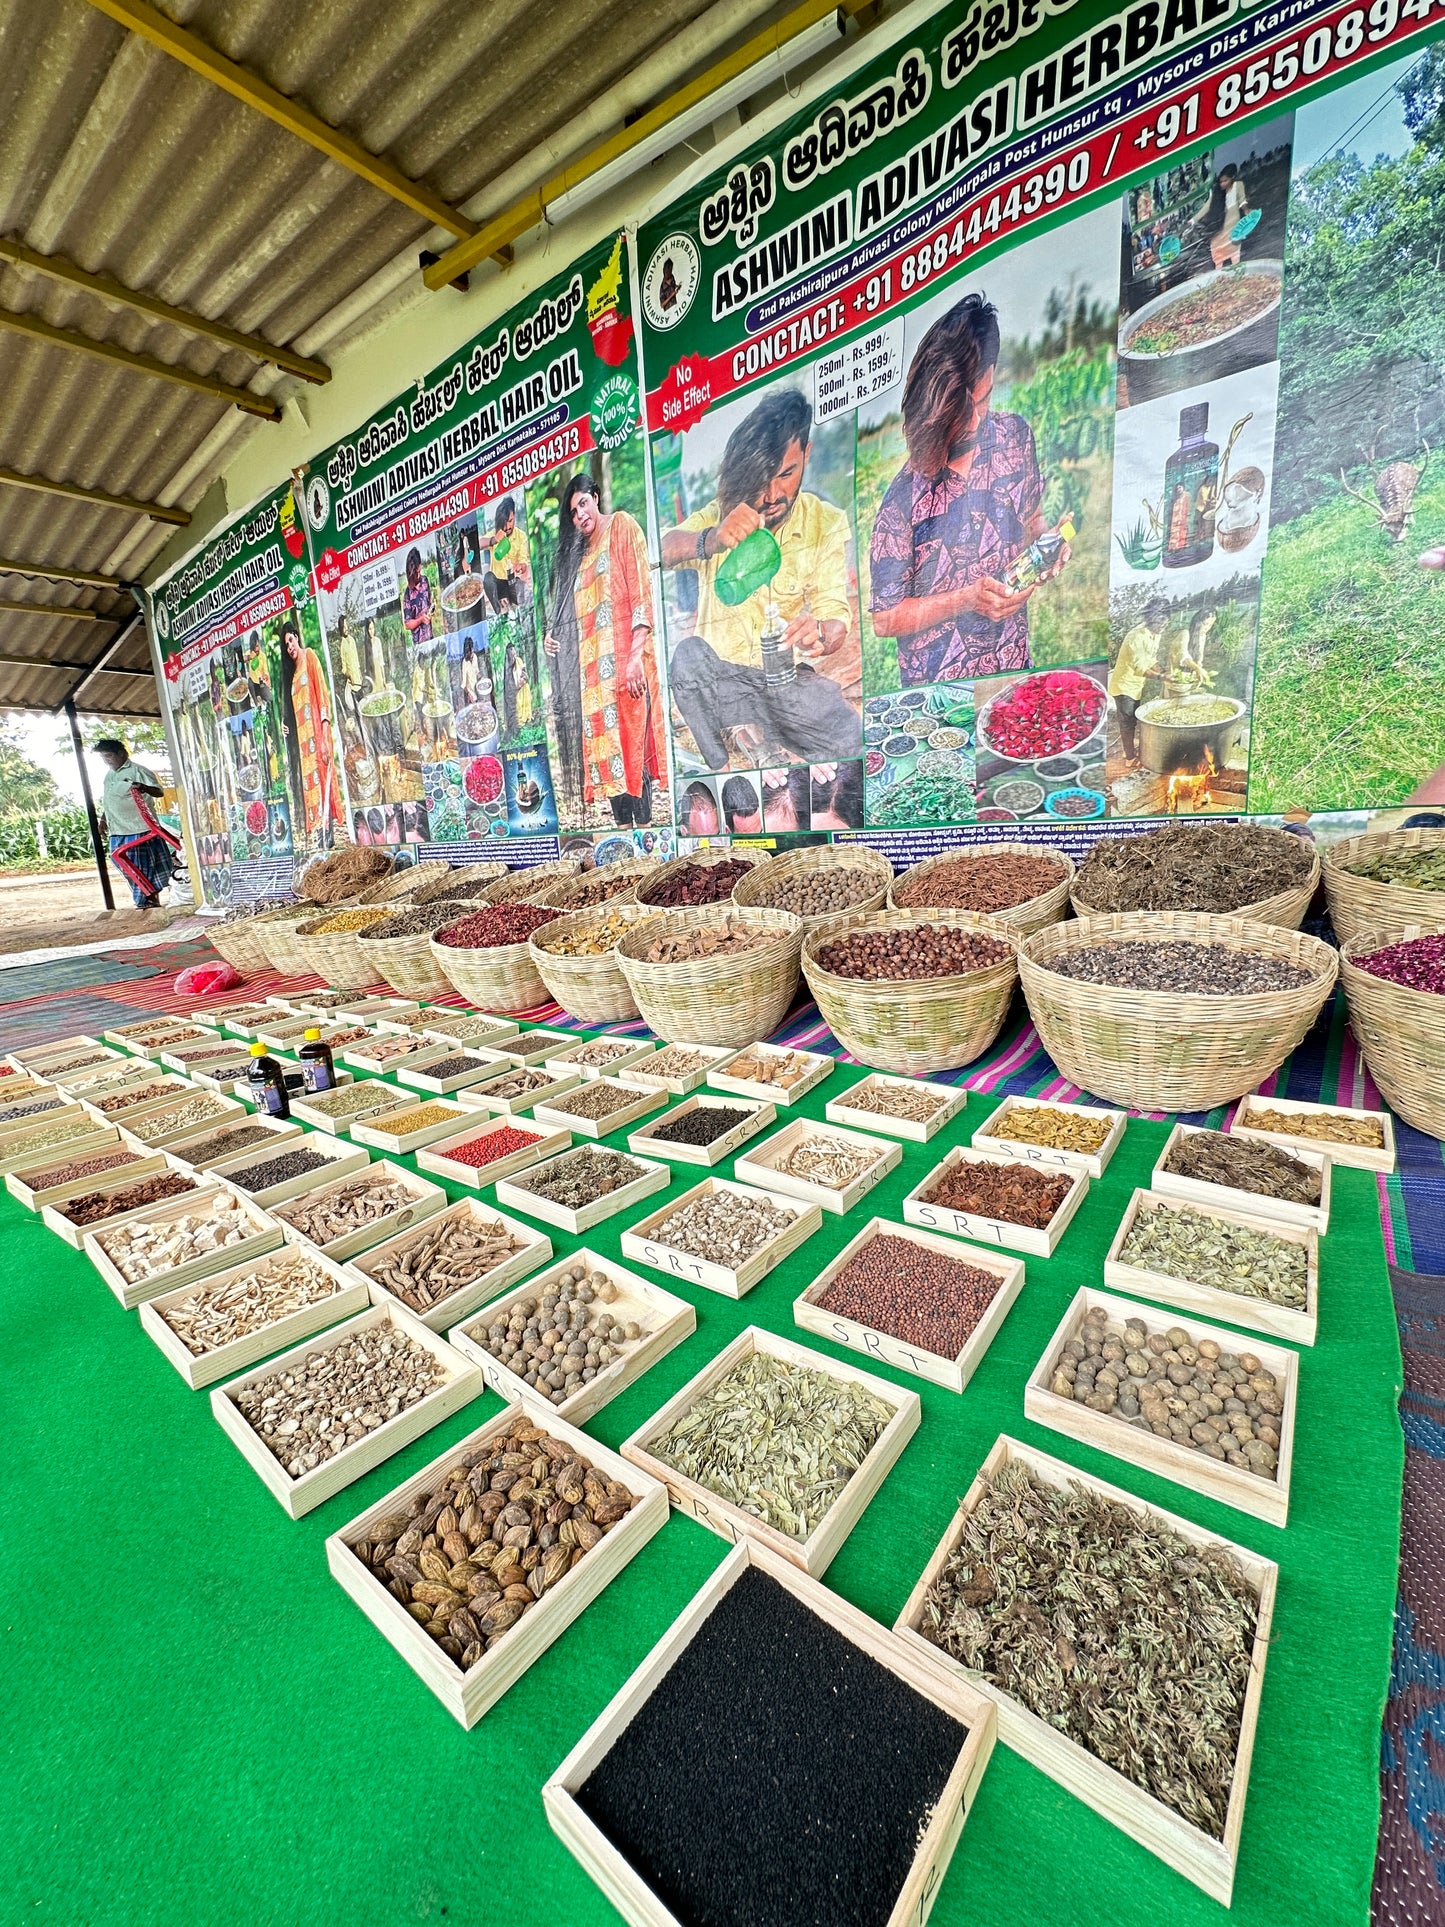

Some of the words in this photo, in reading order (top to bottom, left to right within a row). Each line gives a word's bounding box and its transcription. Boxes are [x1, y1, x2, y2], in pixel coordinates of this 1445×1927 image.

[787, 55, 927, 184] ಆದಿವಾಸಿ
[947, 0, 1039, 81] ಹರ್ಬ
[759, 304, 776, 321] 2nd
[779, 263, 848, 311] Pakshirajpura
[851, 236, 891, 271] Adivasi
[893, 208, 934, 243] Colony
[935, 162, 1000, 215] Nellurpala
[1004, 141, 1037, 168] Post
[1041, 109, 1100, 146] Hunsur
[1104, 97, 1122, 119] tq
[1136, 52, 1203, 99] Mysore
[1209, 28, 1248, 60] Dist
[1253, 0, 1323, 37] Karna
[716, 197, 848, 316] ASHWINI
[860, 85, 1009, 235] ADIVASI
[732, 301, 845, 381] CONCTACT:
[853, 268, 892, 312] +91
[901, 151, 1090, 291] 8884444390
[1134, 93, 1200, 149] +91
[1215, 0, 1445, 119] 855089
[646, 245, 668, 292] ADIVASI
[670, 239, 694, 264] HERBAL
[686, 265, 697, 298] HAIR
[645, 295, 670, 325] ASHWINI
[675, 300, 687, 317] OIL
[676, 365, 692, 387] No
[818, 354, 844, 379] 250ml
[852, 332, 890, 362] Rs.999/-
[819, 375, 845, 398] 500ml
[853, 365, 866, 382] Rs.
[868, 351, 896, 374] 1599/-
[594, 375, 632, 408] NATURAL
[662, 397, 682, 423] Side
[684, 380, 711, 412] Effect
[819, 392, 849, 417] 1000ml
[856, 384, 870, 399] Rs.
[872, 369, 900, 393] 2799/-
[337, 477, 386, 528] ASHWINI
[388, 442, 440, 497] ADIVASI
[442, 405, 500, 465] HERBAL
[502, 376, 545, 428] HAIR
[549, 354, 581, 399] OIL
[599, 415, 636, 450] PRODUCT
[347, 532, 390, 569] CONCTACT:
[392, 522, 407, 543] +91
[409, 488, 469, 537] 8884444390
[481, 471, 499, 497] +91
[501, 427, 579, 488] 8550894373
[220, 569, 244, 604] HERBAL
[244, 556, 267, 586] HAIR
[267, 548, 283, 573] OIL
